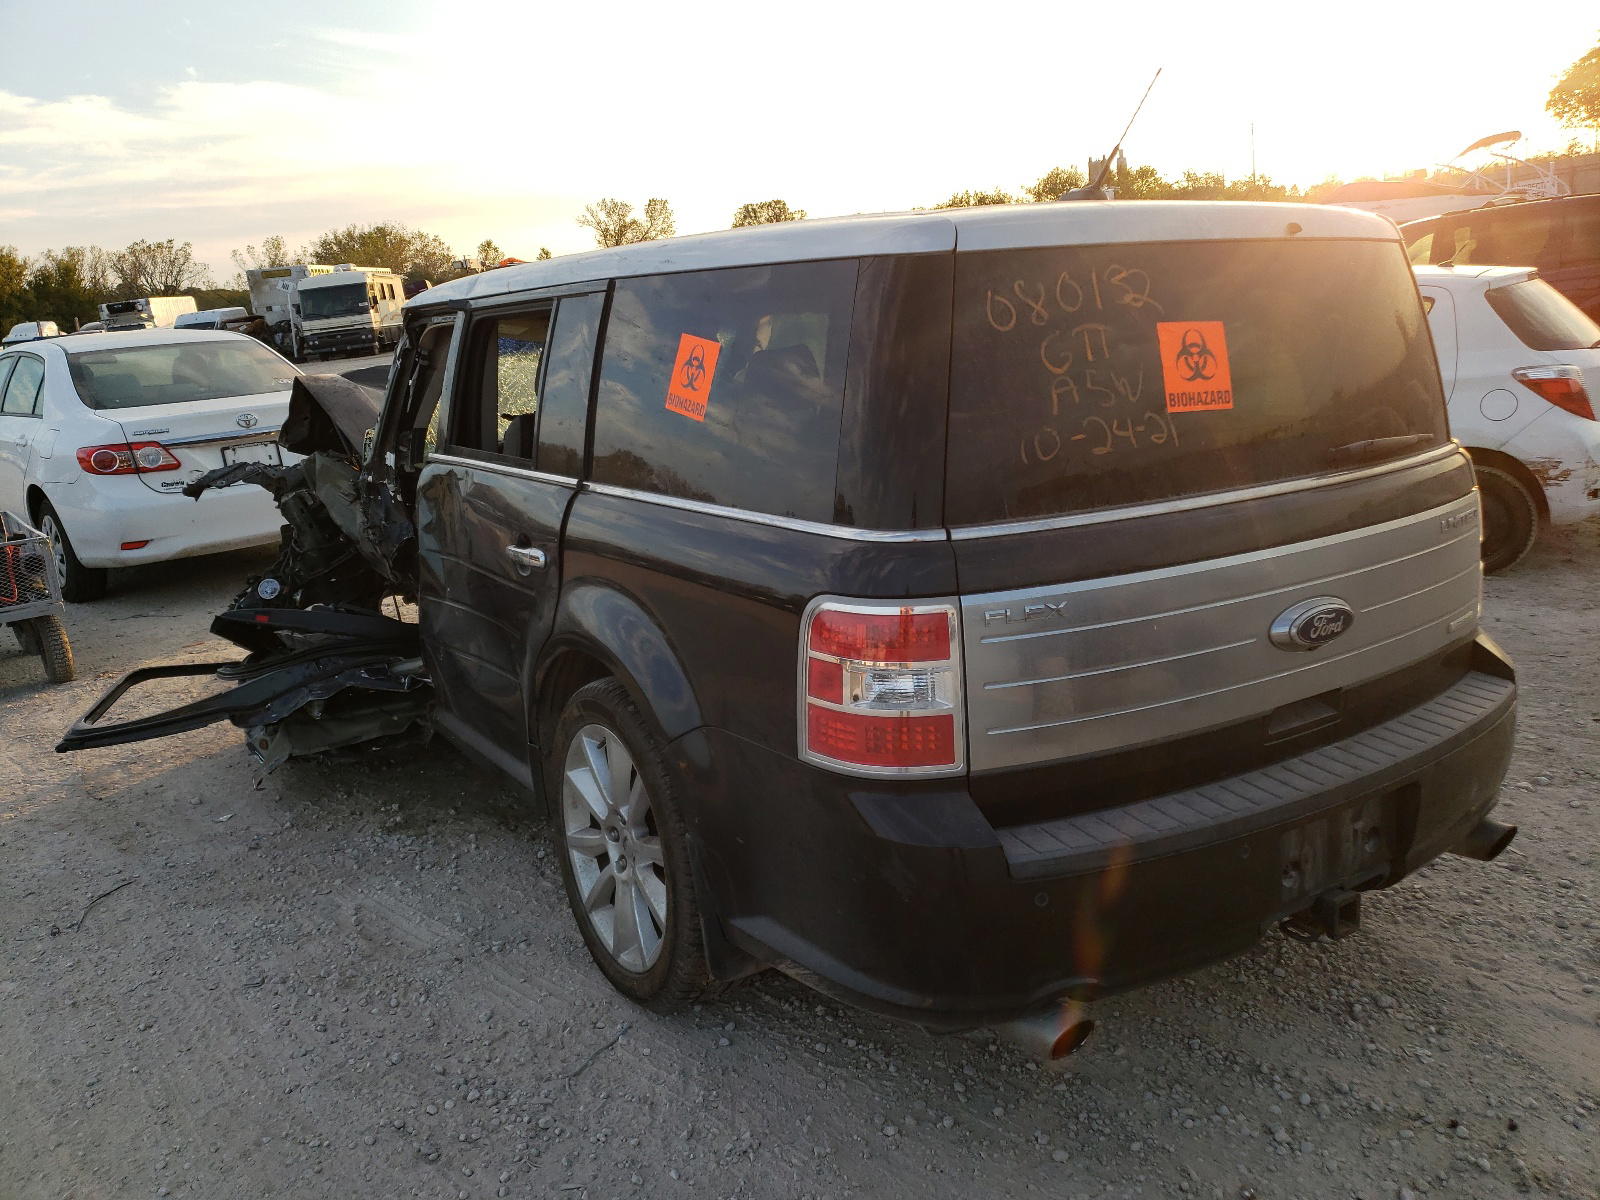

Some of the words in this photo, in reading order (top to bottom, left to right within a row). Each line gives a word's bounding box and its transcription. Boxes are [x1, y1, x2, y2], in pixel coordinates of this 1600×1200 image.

[668, 393, 705, 417] BIOHAZARD
[1168, 390, 1231, 408] BIOHAZARD
[983, 601, 1068, 628] FLEX
[1310, 612, 1344, 639] Ford
